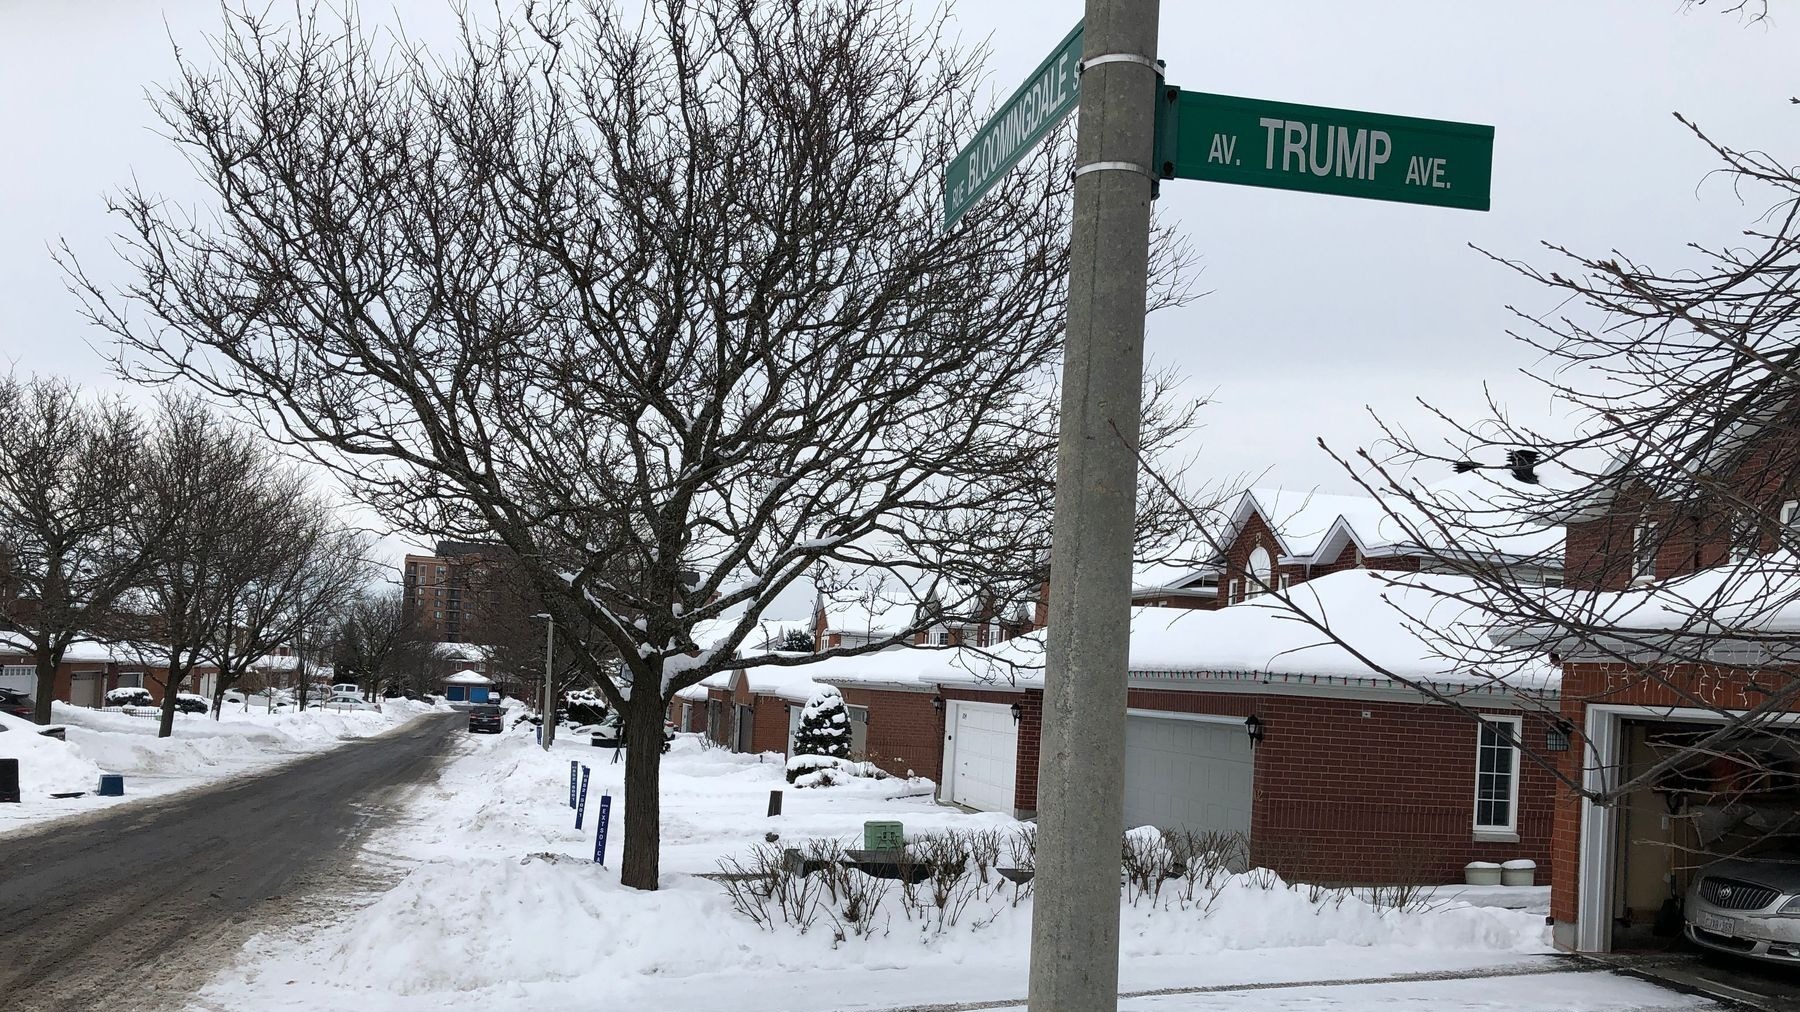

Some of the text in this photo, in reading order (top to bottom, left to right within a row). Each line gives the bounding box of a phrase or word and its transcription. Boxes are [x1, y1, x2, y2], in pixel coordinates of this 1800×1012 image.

[951, 52, 1083, 211] RUE BLOOMINGDALE S
[1207, 116, 1452, 189] AV. TRUMP AVE.
